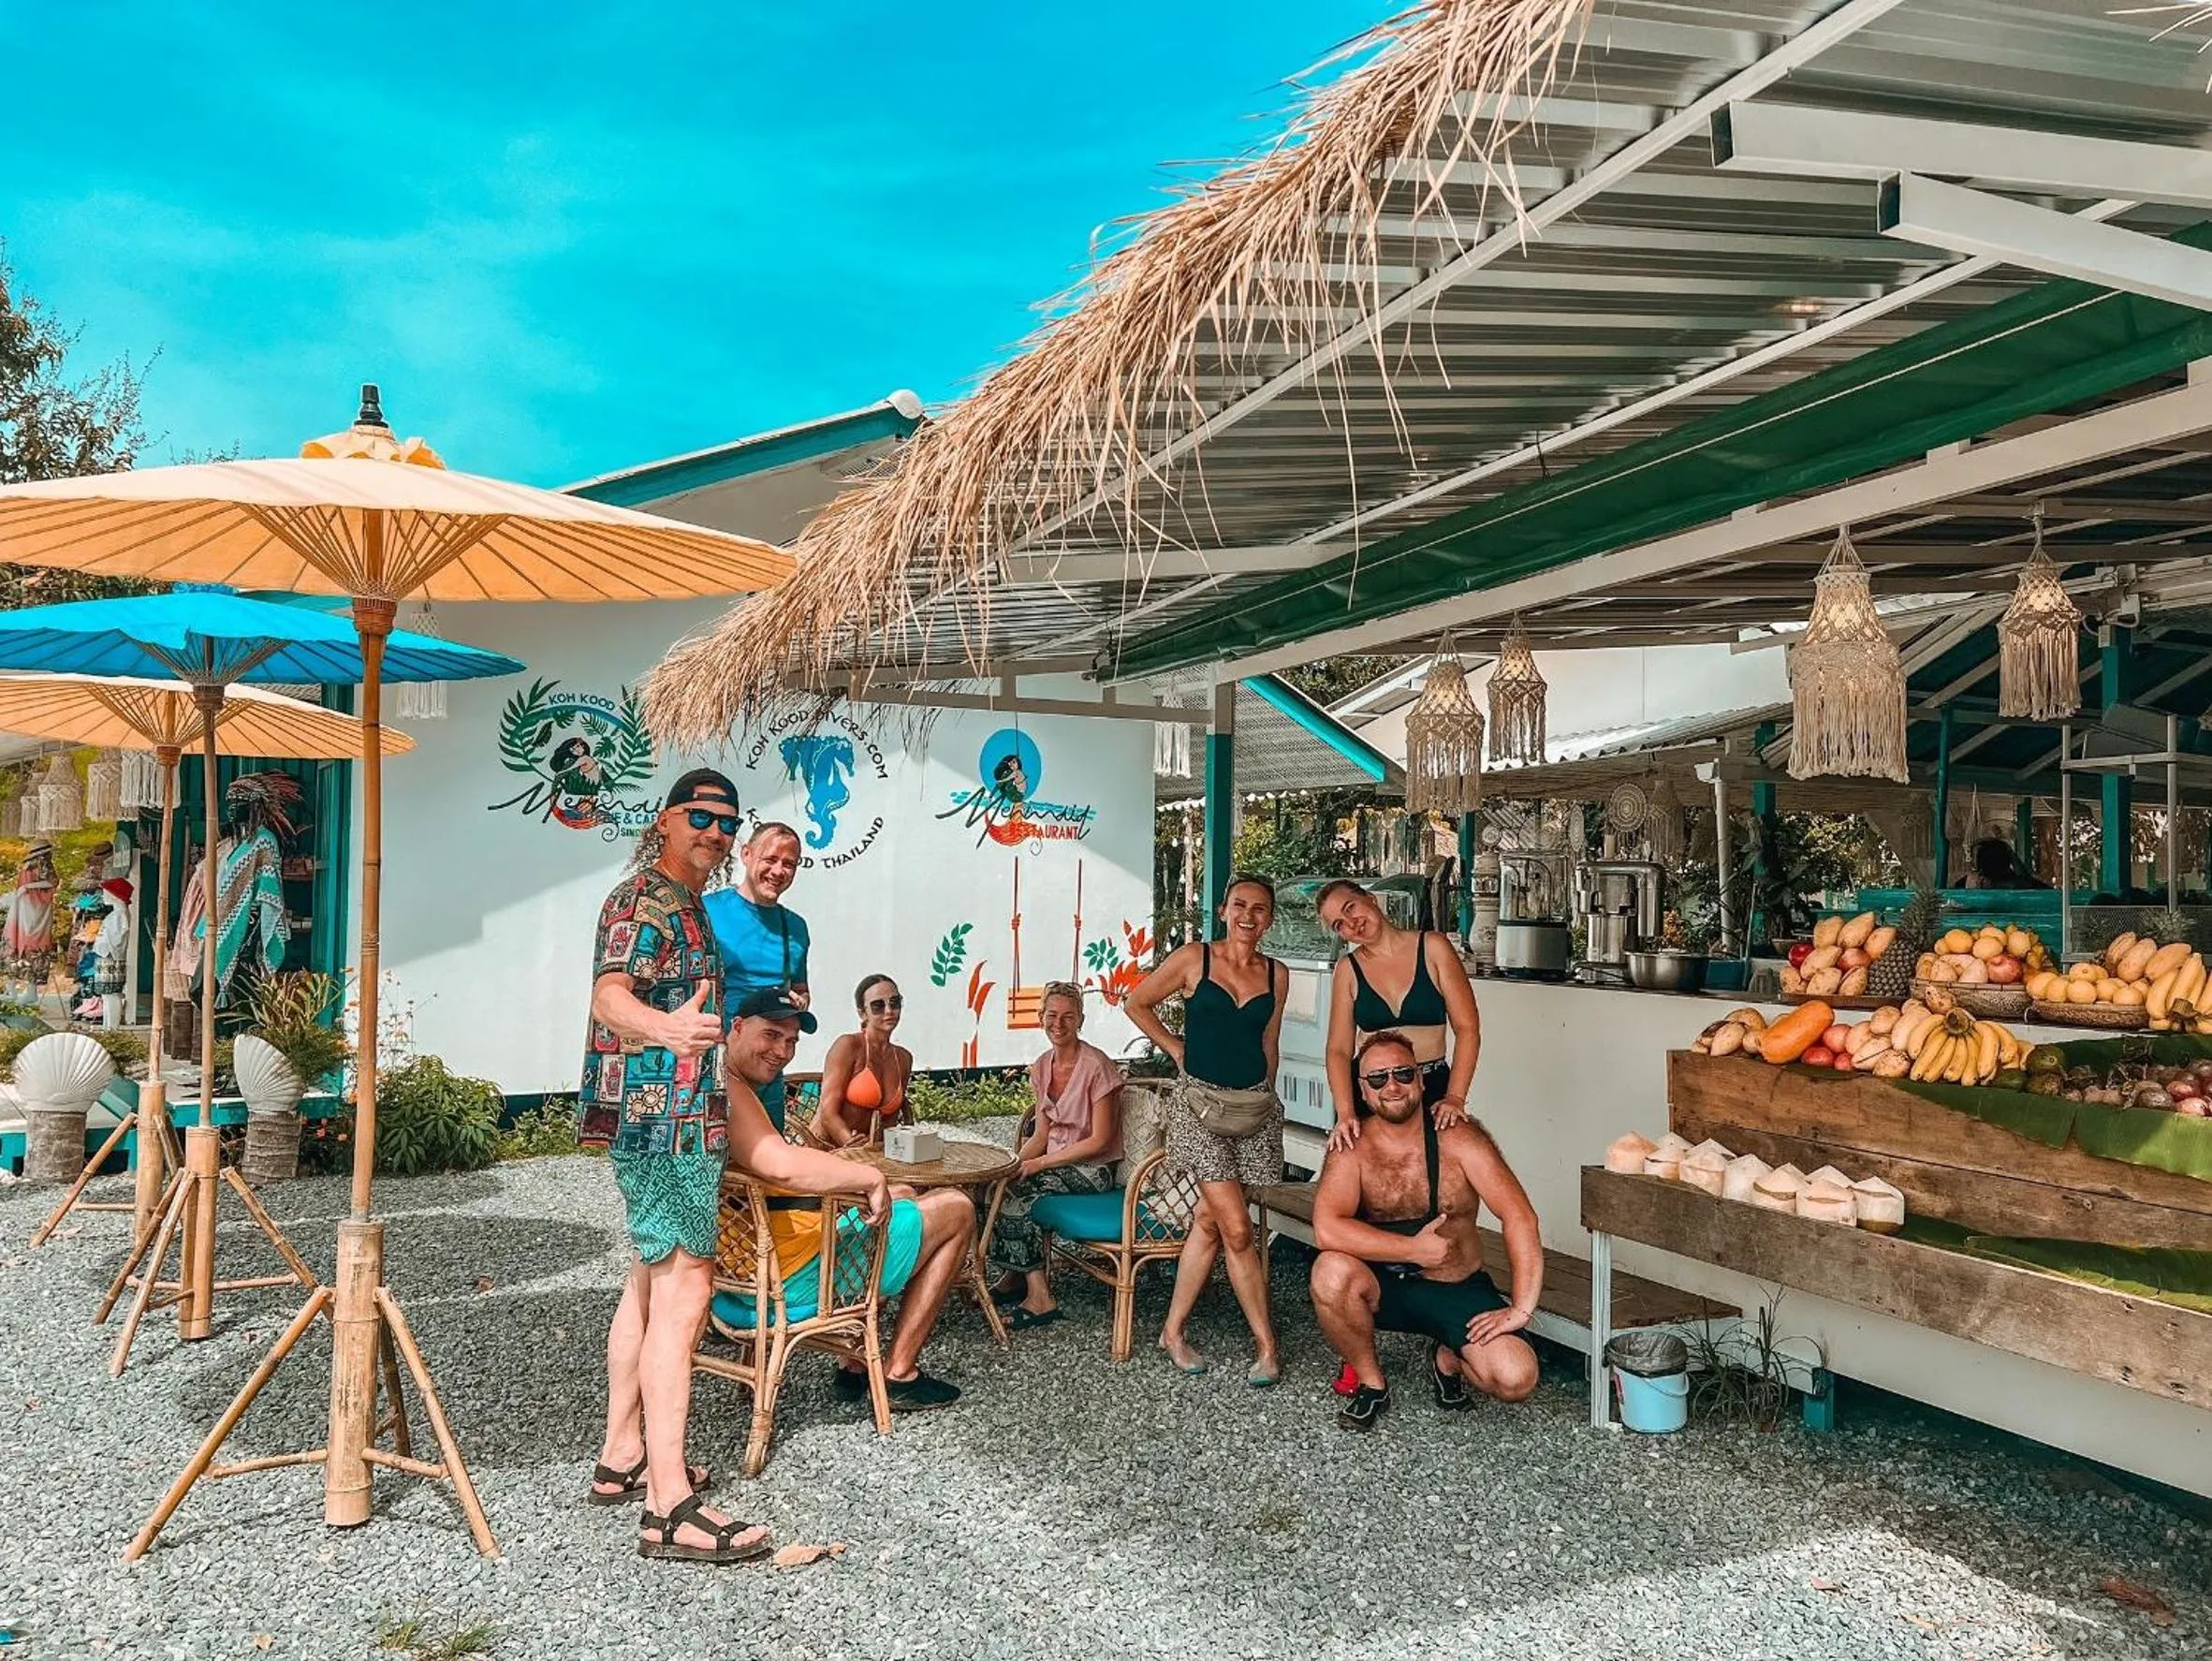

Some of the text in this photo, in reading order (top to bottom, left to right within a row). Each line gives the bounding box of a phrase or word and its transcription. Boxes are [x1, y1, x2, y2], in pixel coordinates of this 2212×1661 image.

[548, 693, 616, 712] KOH KOOD
[745, 735, 769, 771] KOH
[769, 709, 810, 738] KOOD
[623, 814, 632, 824] &
[635, 814, 658, 825] CAF
[822, 816, 885, 869] THAILAND
[934, 786, 1091, 849] Mermaid
